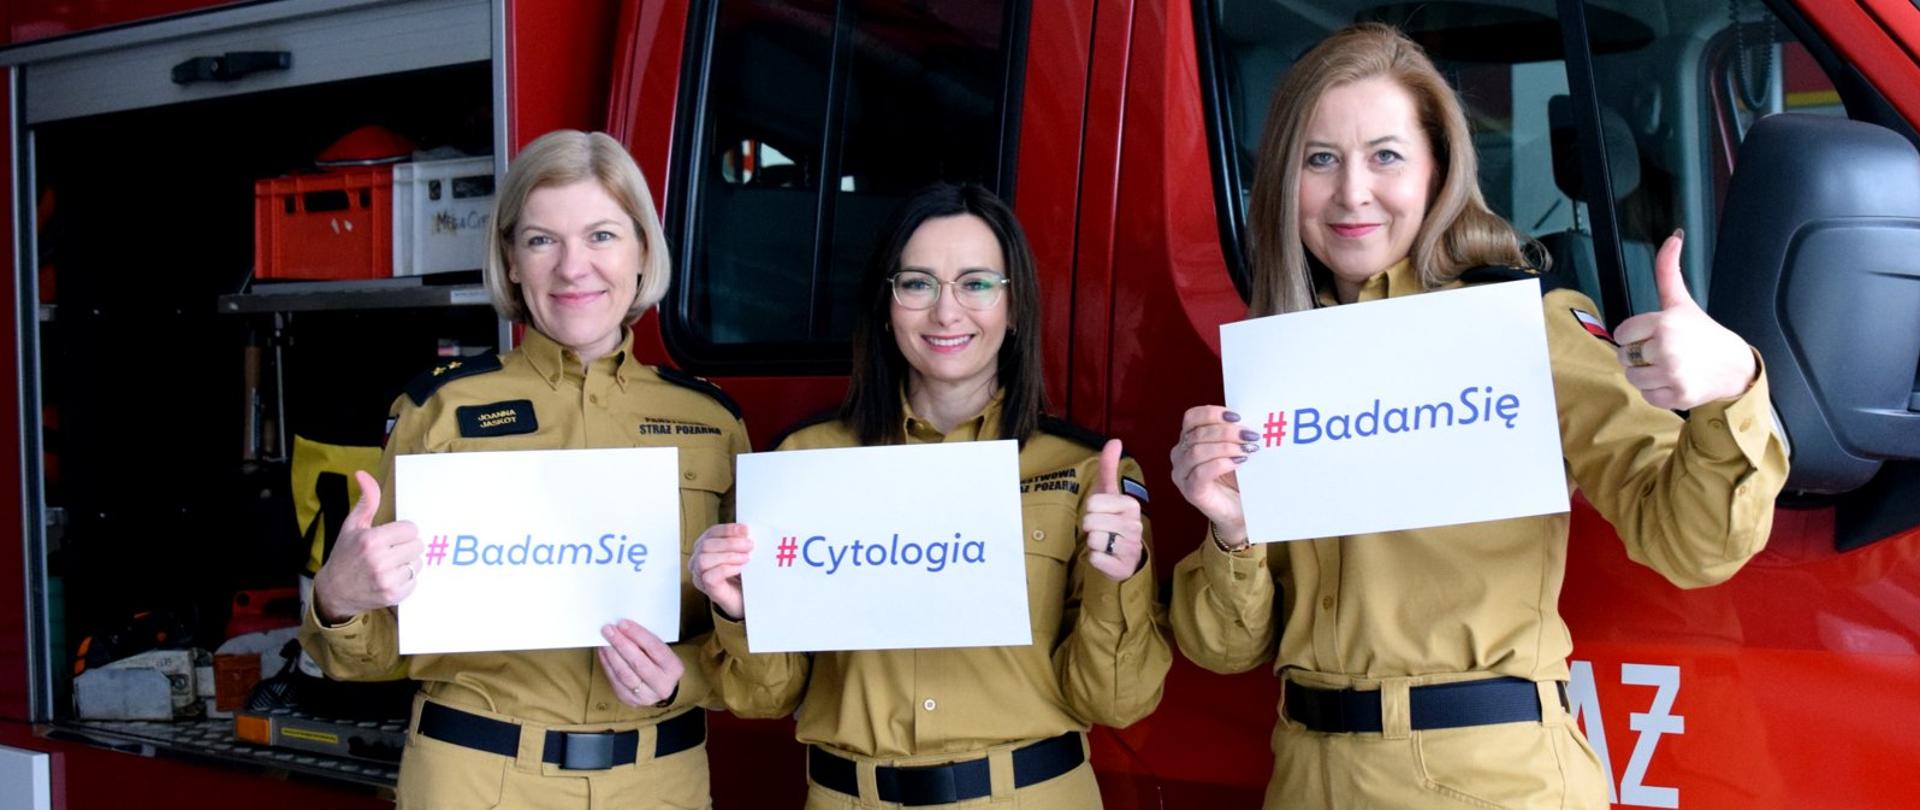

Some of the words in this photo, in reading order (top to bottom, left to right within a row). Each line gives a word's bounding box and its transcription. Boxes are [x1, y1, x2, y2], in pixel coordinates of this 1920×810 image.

[478, 409, 516, 421] JOANNA
[1262, 386, 1520, 447] #BadamSię
[426, 534, 648, 572] #BadamSię
[776, 532, 986, 575] #Cytologia
